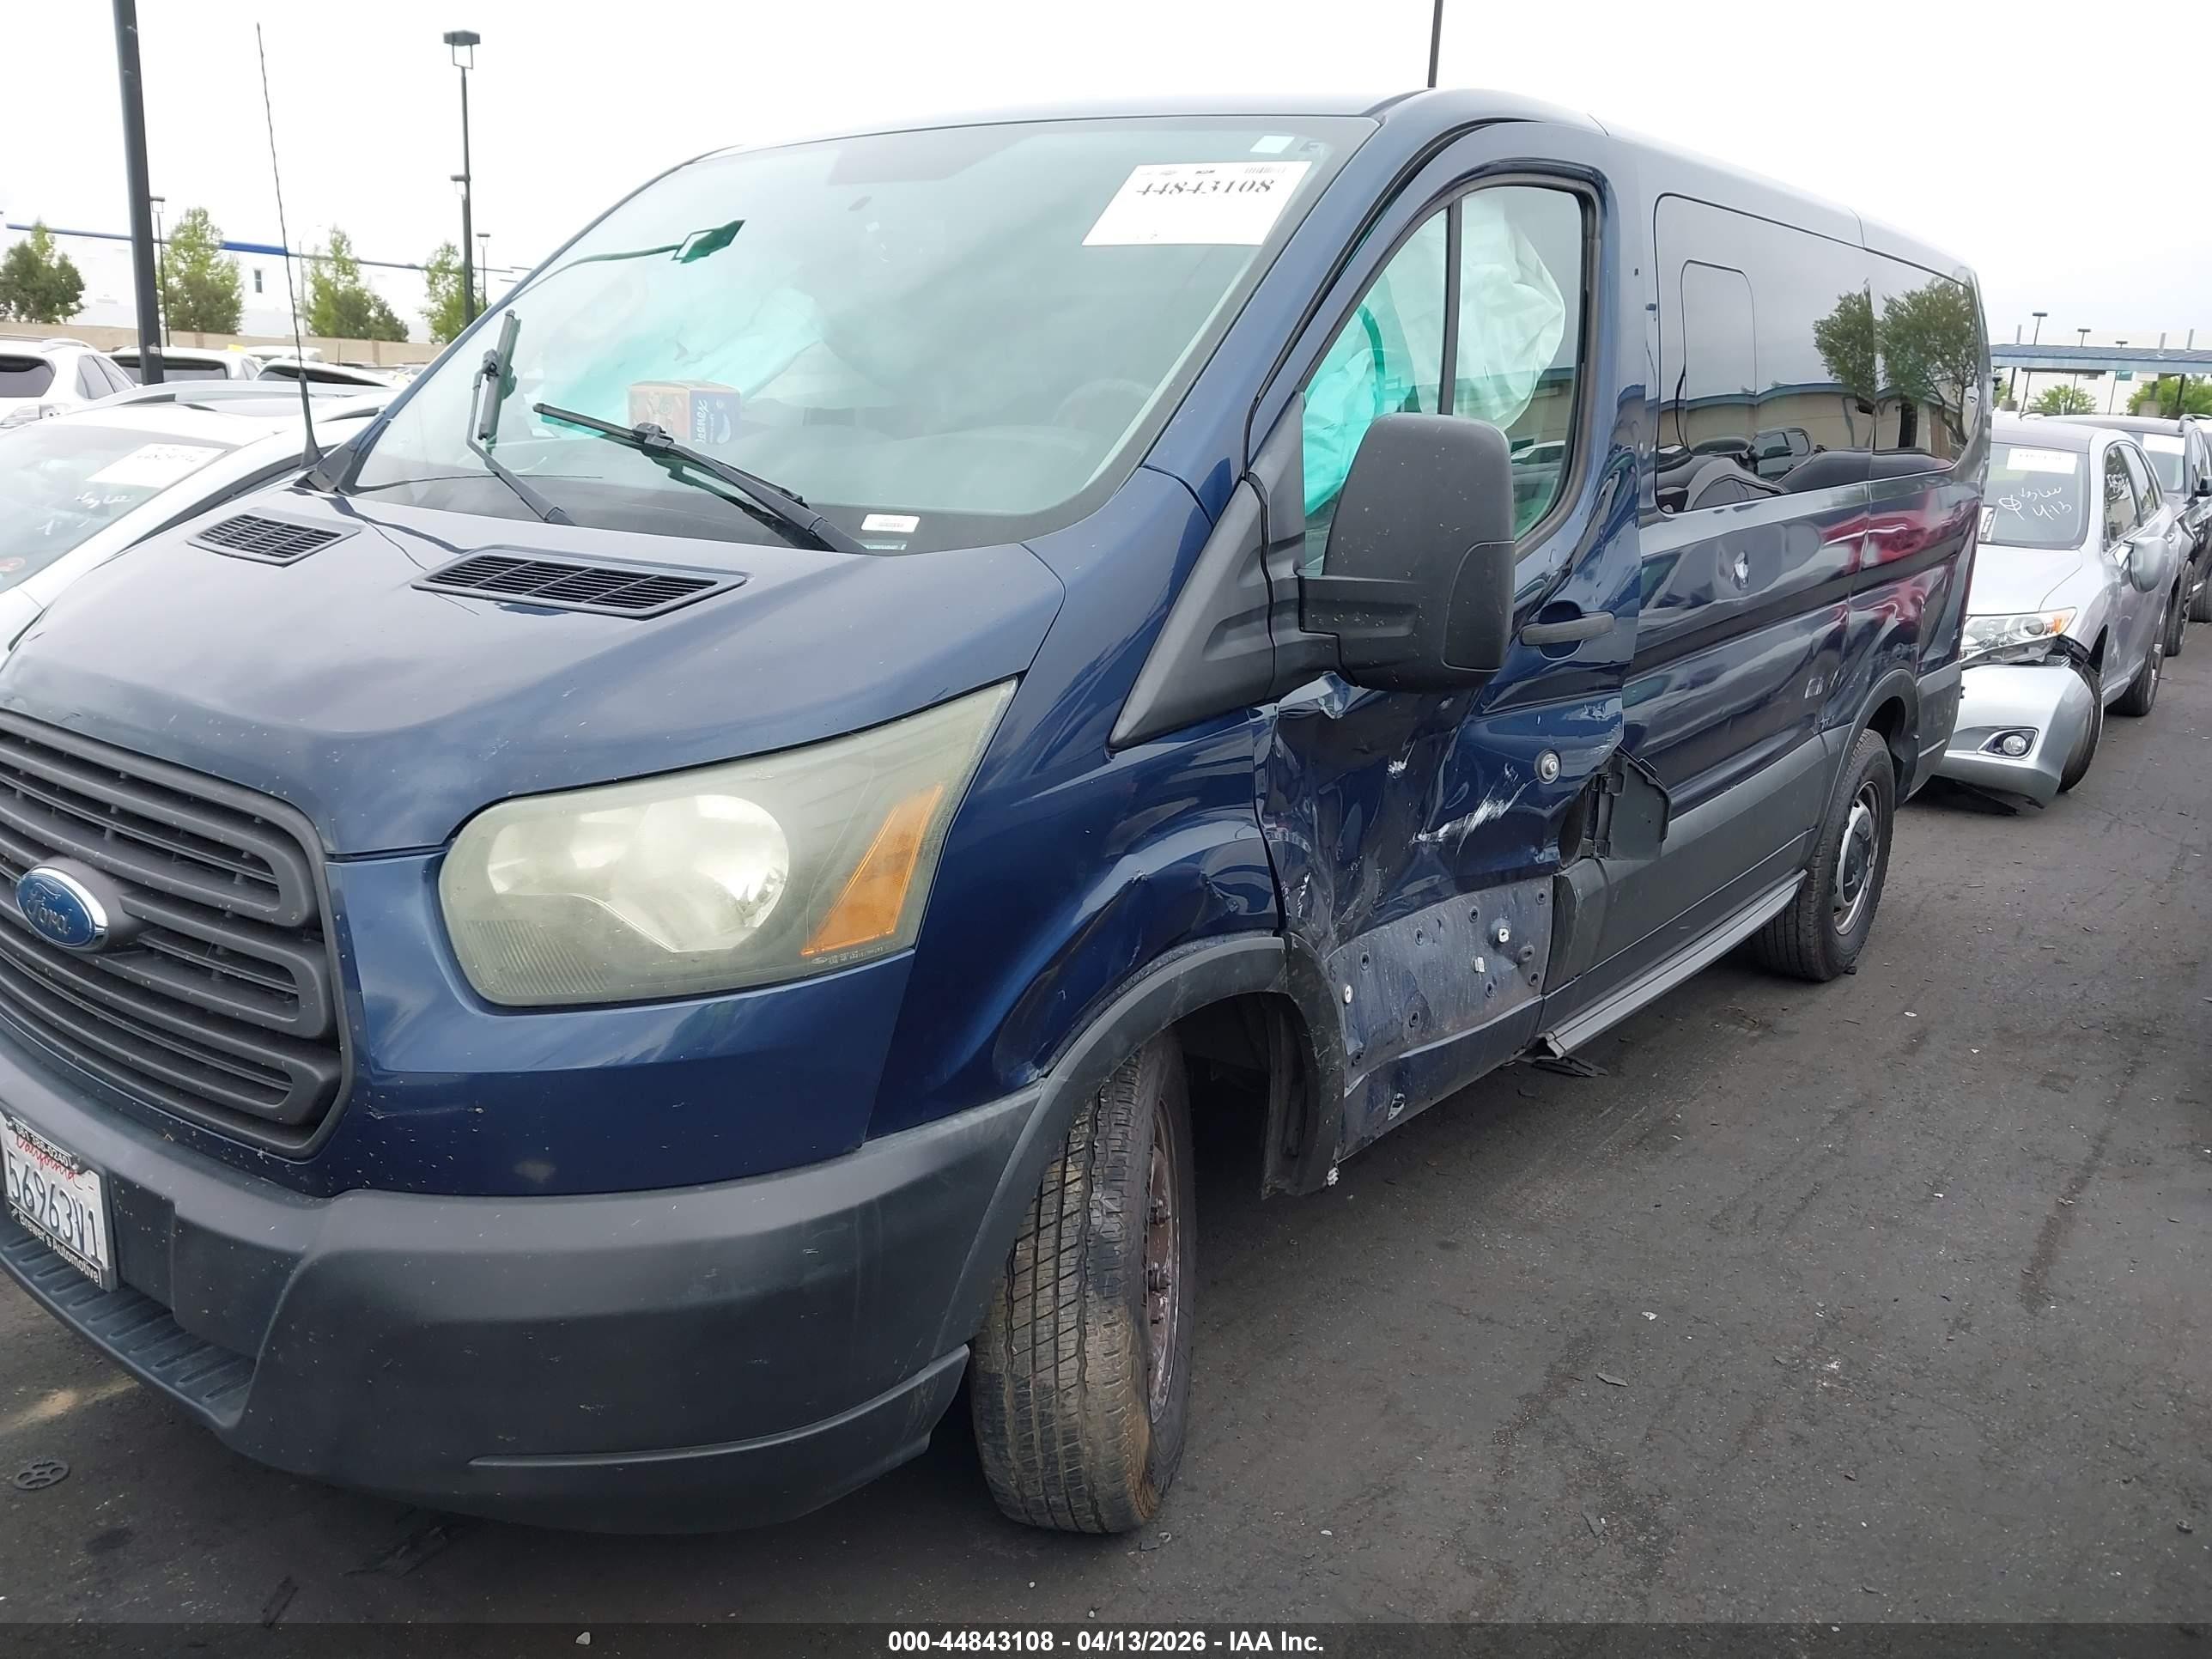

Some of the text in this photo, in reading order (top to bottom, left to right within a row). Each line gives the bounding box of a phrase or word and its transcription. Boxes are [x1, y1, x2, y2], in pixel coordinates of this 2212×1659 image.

[1135, 179, 1275, 196] 44843108
[27, 882, 73, 935] Ford
[6, 1147, 99, 1260] 56963V1
[19, 1212, 100, 1285] Brewer's Automotive
